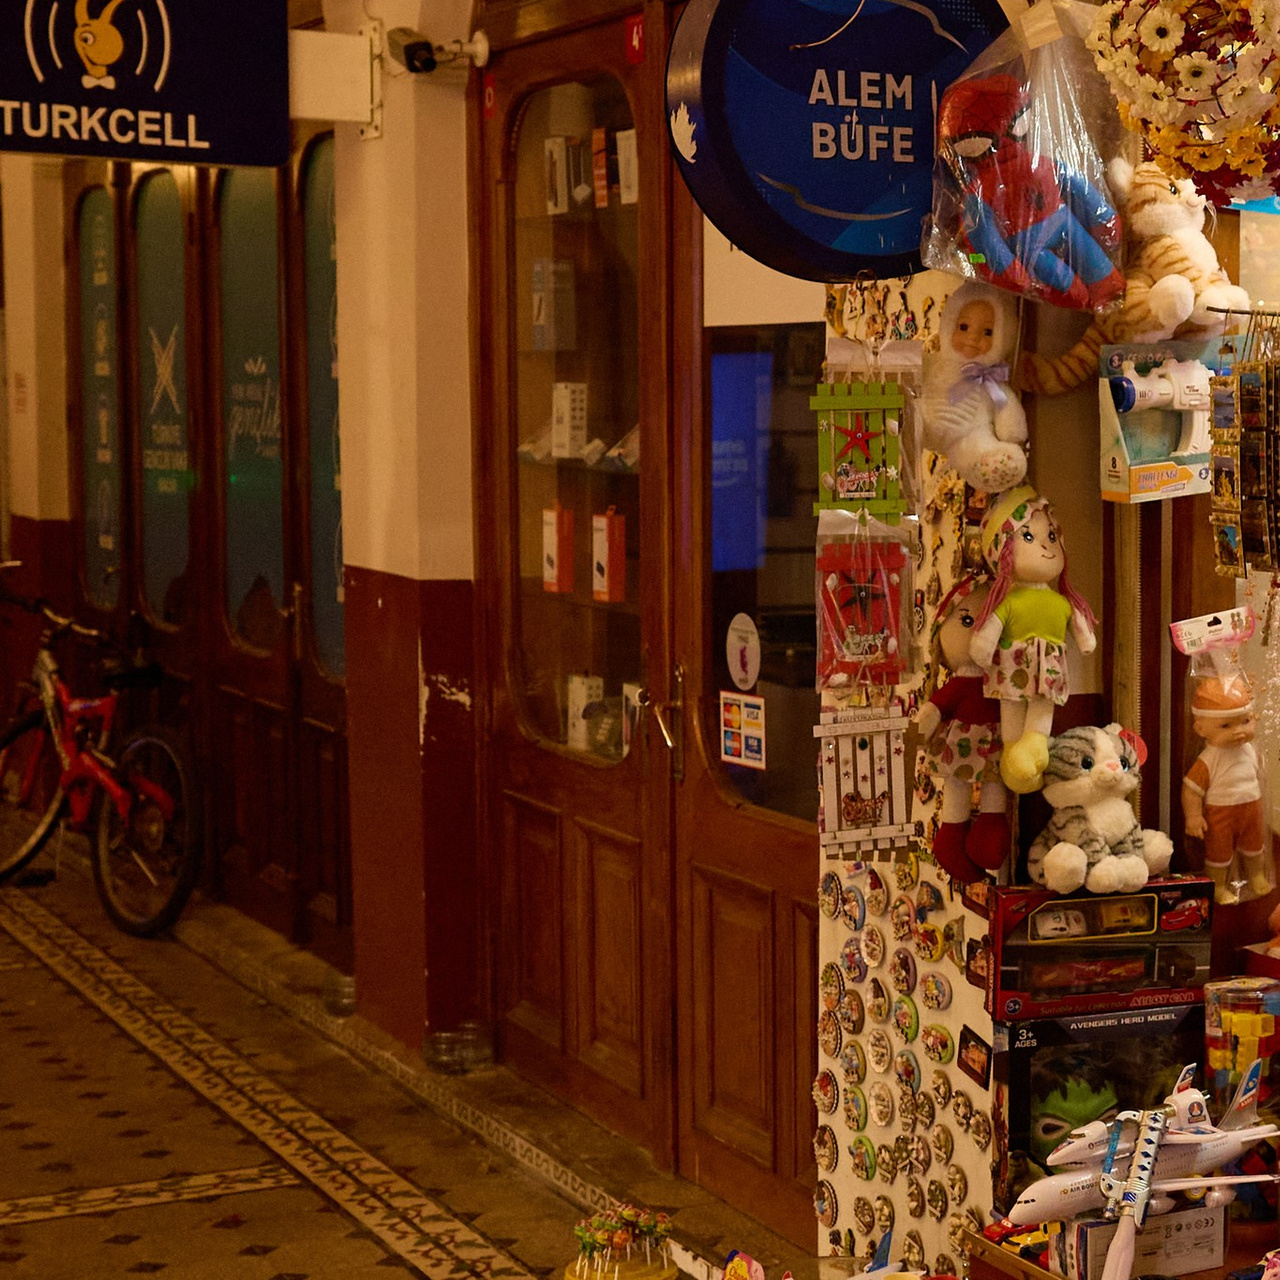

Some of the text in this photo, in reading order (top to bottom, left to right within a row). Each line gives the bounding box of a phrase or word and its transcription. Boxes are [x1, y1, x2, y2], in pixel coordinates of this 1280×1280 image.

[807, 68, 915, 111] ALEM
[0, 99, 212, 150] TURKCELL
[812, 110, 916, 163] BÜFE
[1017, 1027, 1035, 1040] 3+
[1068, 1012, 1178, 1030] AVENGERS HERO MODEL
[1013, 1037, 1039, 1049] AGES
